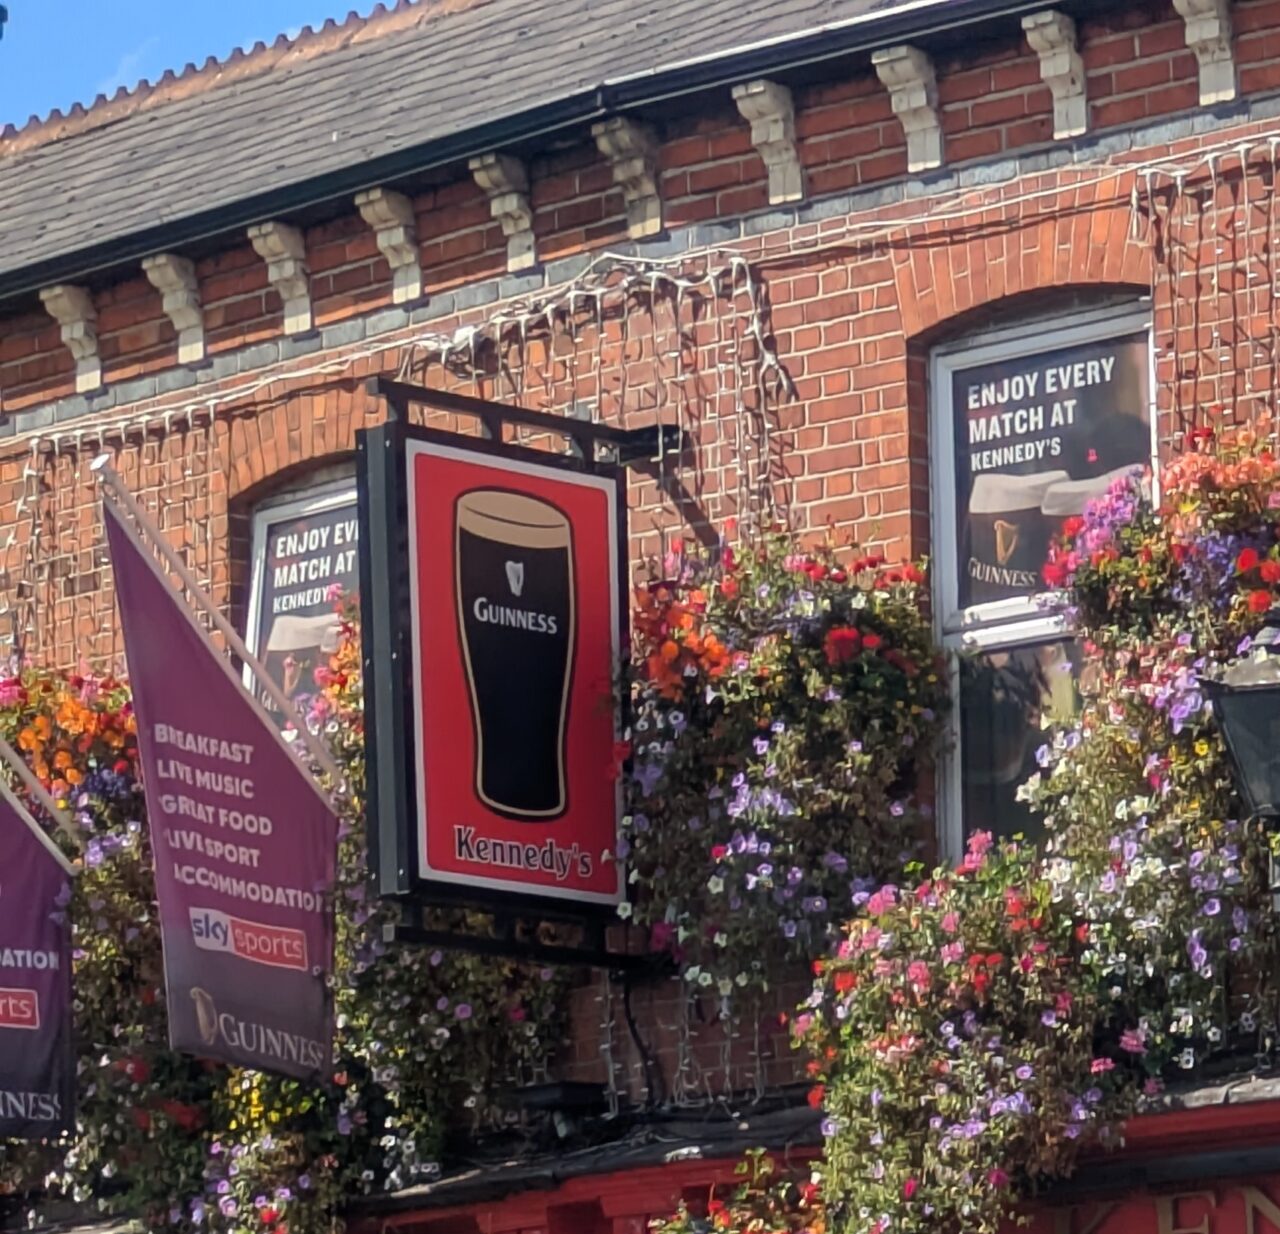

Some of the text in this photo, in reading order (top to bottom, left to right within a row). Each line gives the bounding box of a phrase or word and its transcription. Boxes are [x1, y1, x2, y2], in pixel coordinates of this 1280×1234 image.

[968, 357, 1115, 409] ENJOY EVERY
[969, 400, 1077, 443] MATCH AT
[971, 437, 1061, 471] KENNEDY'S
[276, 525, 331, 558] ENJOY
[274, 550, 355, 588] MATCH AT
[968, 558, 1038, 587] GUINNESS
[273, 585, 330, 613] KENNEDY
[474, 597, 557, 634] GUINNESS
[196, 769, 254, 798] MUSIC
[219, 809, 272, 835] FOOD
[205, 839, 260, 867] SPORT
[454, 825, 592, 880] Kennedy's
[192, 914, 303, 960] sky sports
[219, 1012, 324, 1069] GUINNESS
